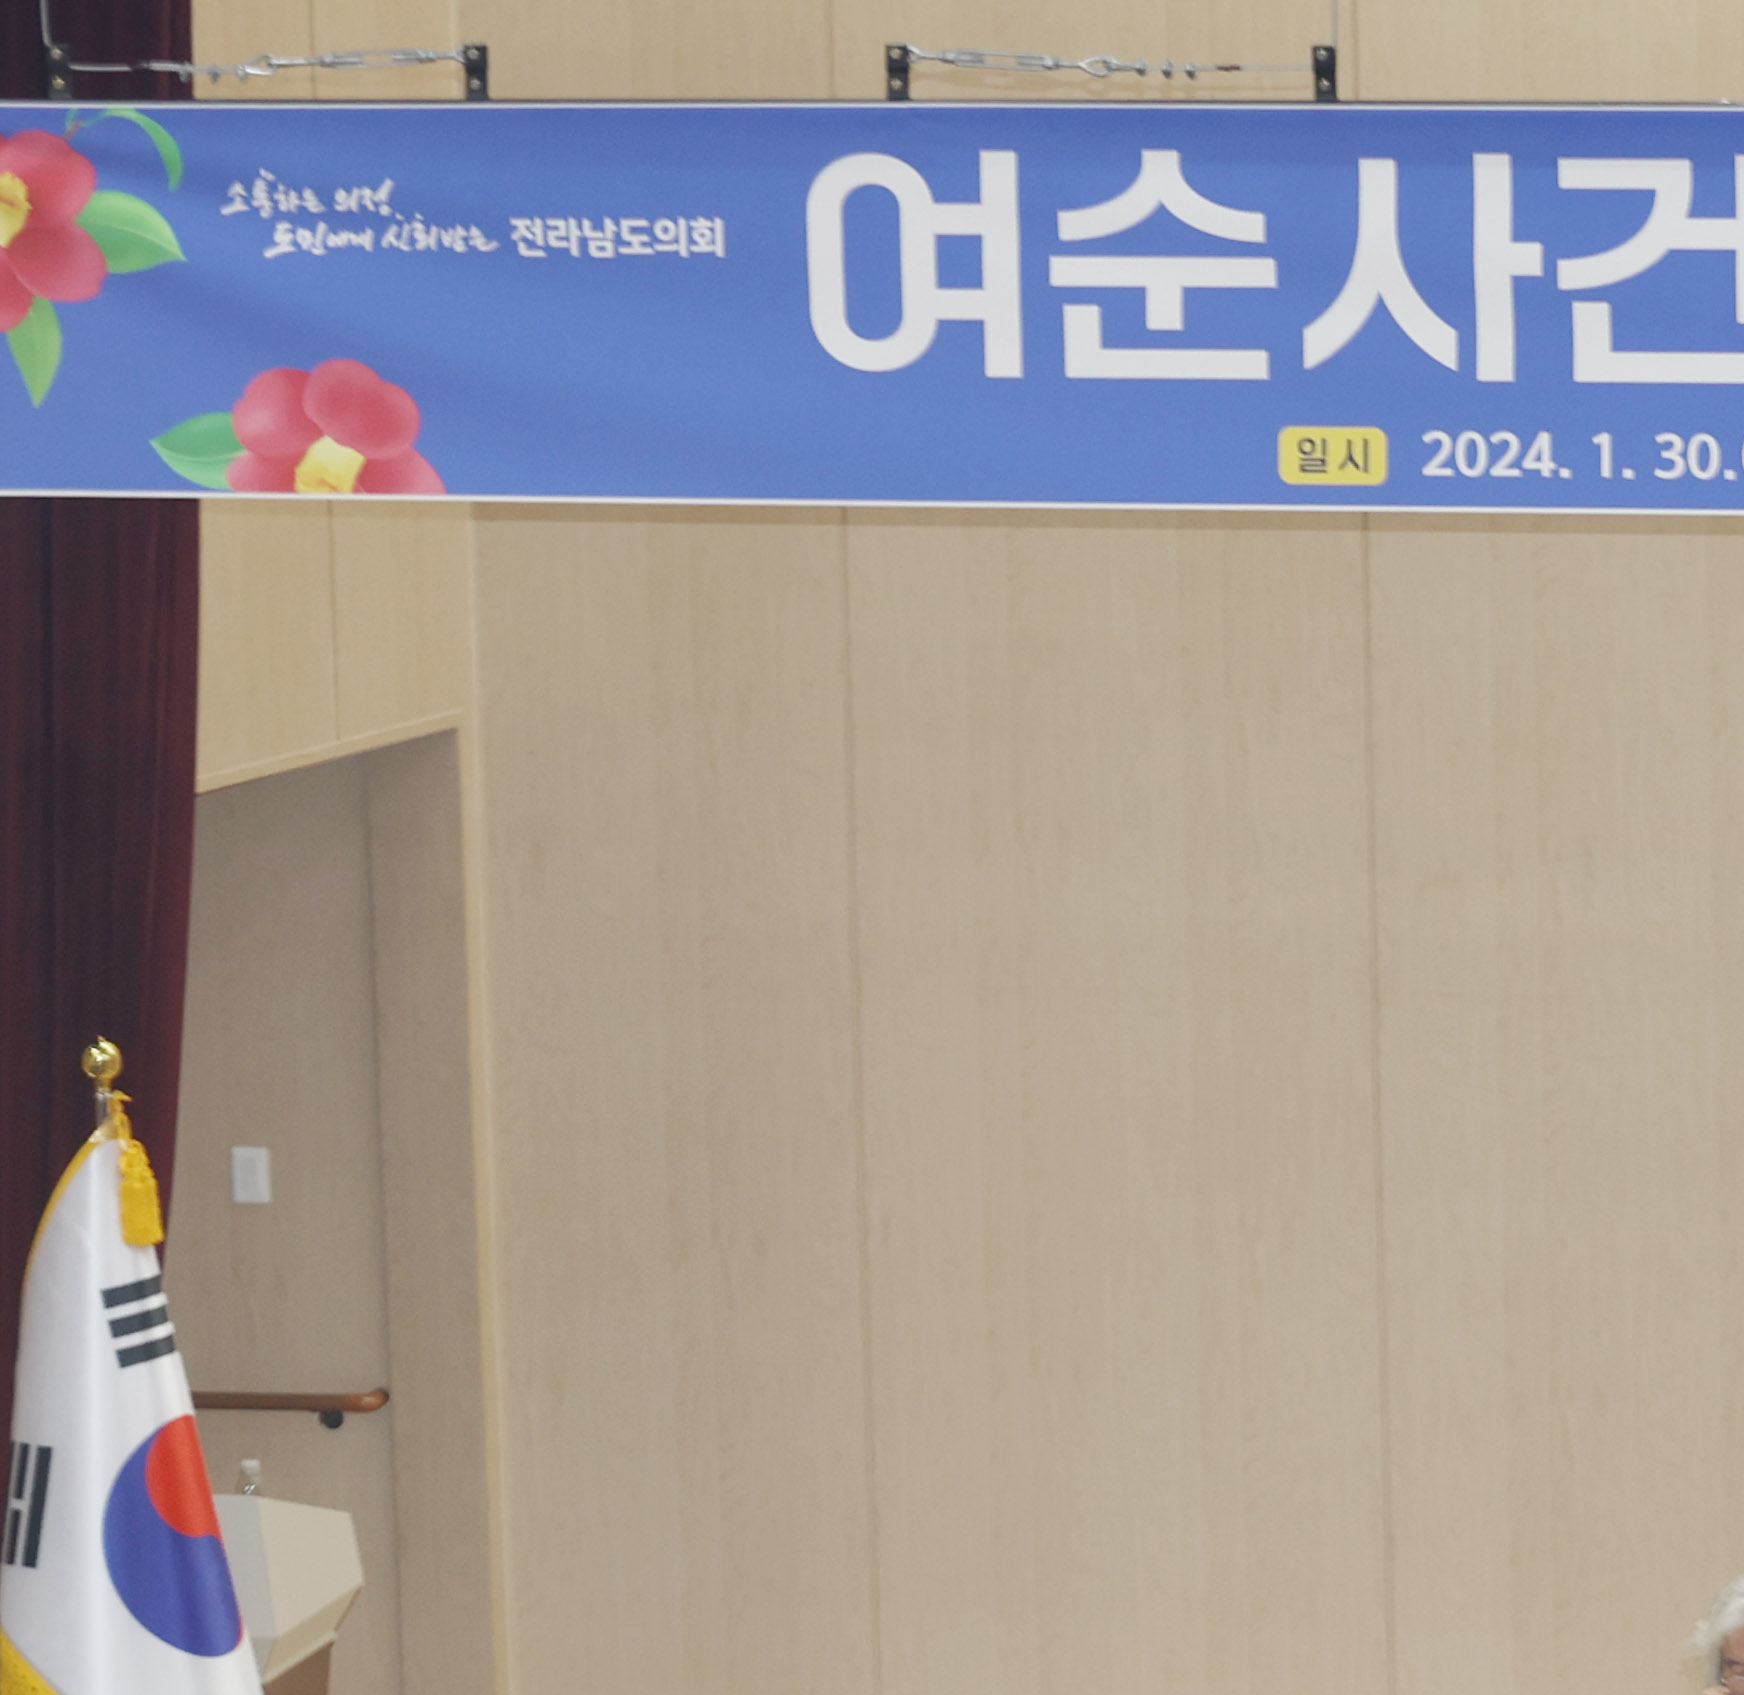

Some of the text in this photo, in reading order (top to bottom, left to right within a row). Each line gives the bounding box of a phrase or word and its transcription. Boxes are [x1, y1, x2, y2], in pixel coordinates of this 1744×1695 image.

[510, 217, 726, 259] 전라남도의회
[1297, 437, 1369, 474] 일시
[1422, 430, 1572, 479] 2024.
[1592, 432, 1636, 479] 1.
